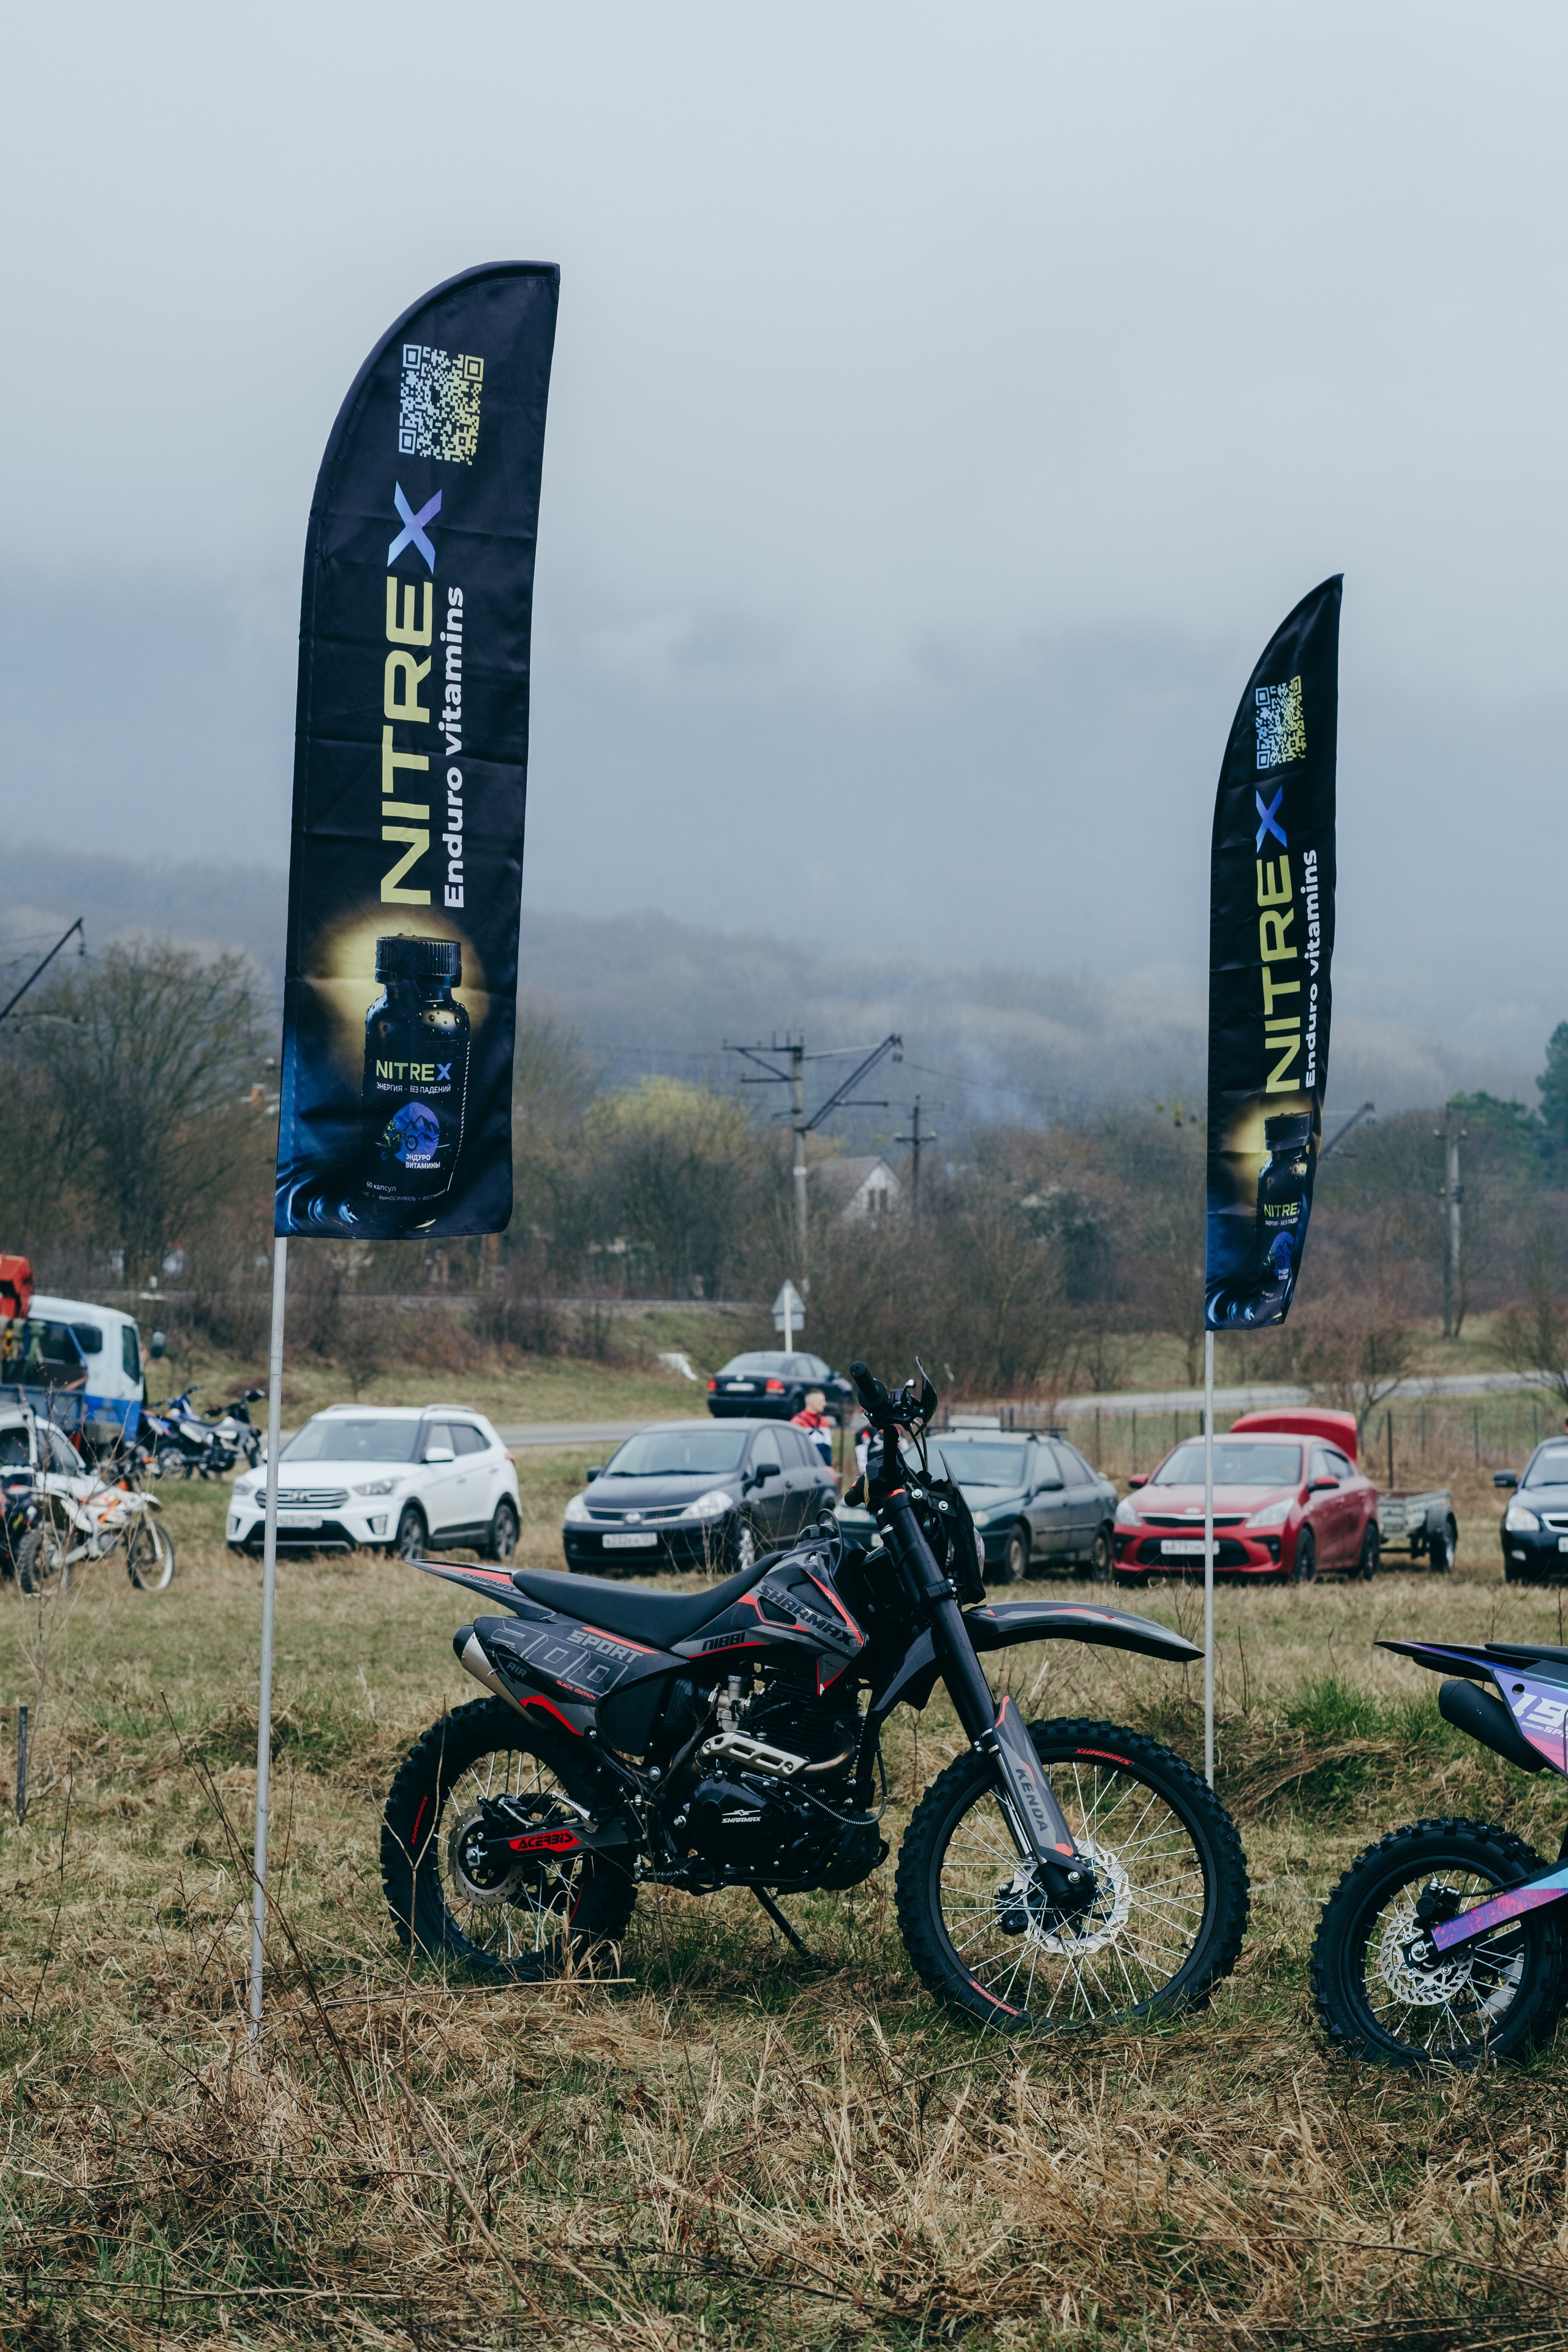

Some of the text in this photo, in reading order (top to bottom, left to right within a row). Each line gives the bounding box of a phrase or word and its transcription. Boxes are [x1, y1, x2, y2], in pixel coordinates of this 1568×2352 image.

[381, 481, 442, 905] NITREX
[439, 587, 464, 908] Enduro vitamins
[1256, 785, 1300, 1093] NITREX
[1300, 850, 1320, 1088] Enduro vitamins
[376, 1060, 451, 1081] NITREX
[376, 1082, 402, 1092] ЭНЕРГИЯ
[420, 1084, 451, 1095] ПАДЕНИЙ
[373, 1184, 396, 1193] капсул
[459, 1573, 516, 1591] SHARMAX
[756, 1581, 858, 1648] SHARMAX
[567, 1630, 644, 1663] SPORT
[506, 1662, 527, 1678] AIR
[556, 1679, 597, 1700] BLACK EDITION
[1512, 1692, 1568, 1730] 19
[1521, 1721, 1545, 1731] MIAMI
[1075, 1748, 1132, 1765] SHARMAX
[1015, 1768, 1049, 1833] KENDA
